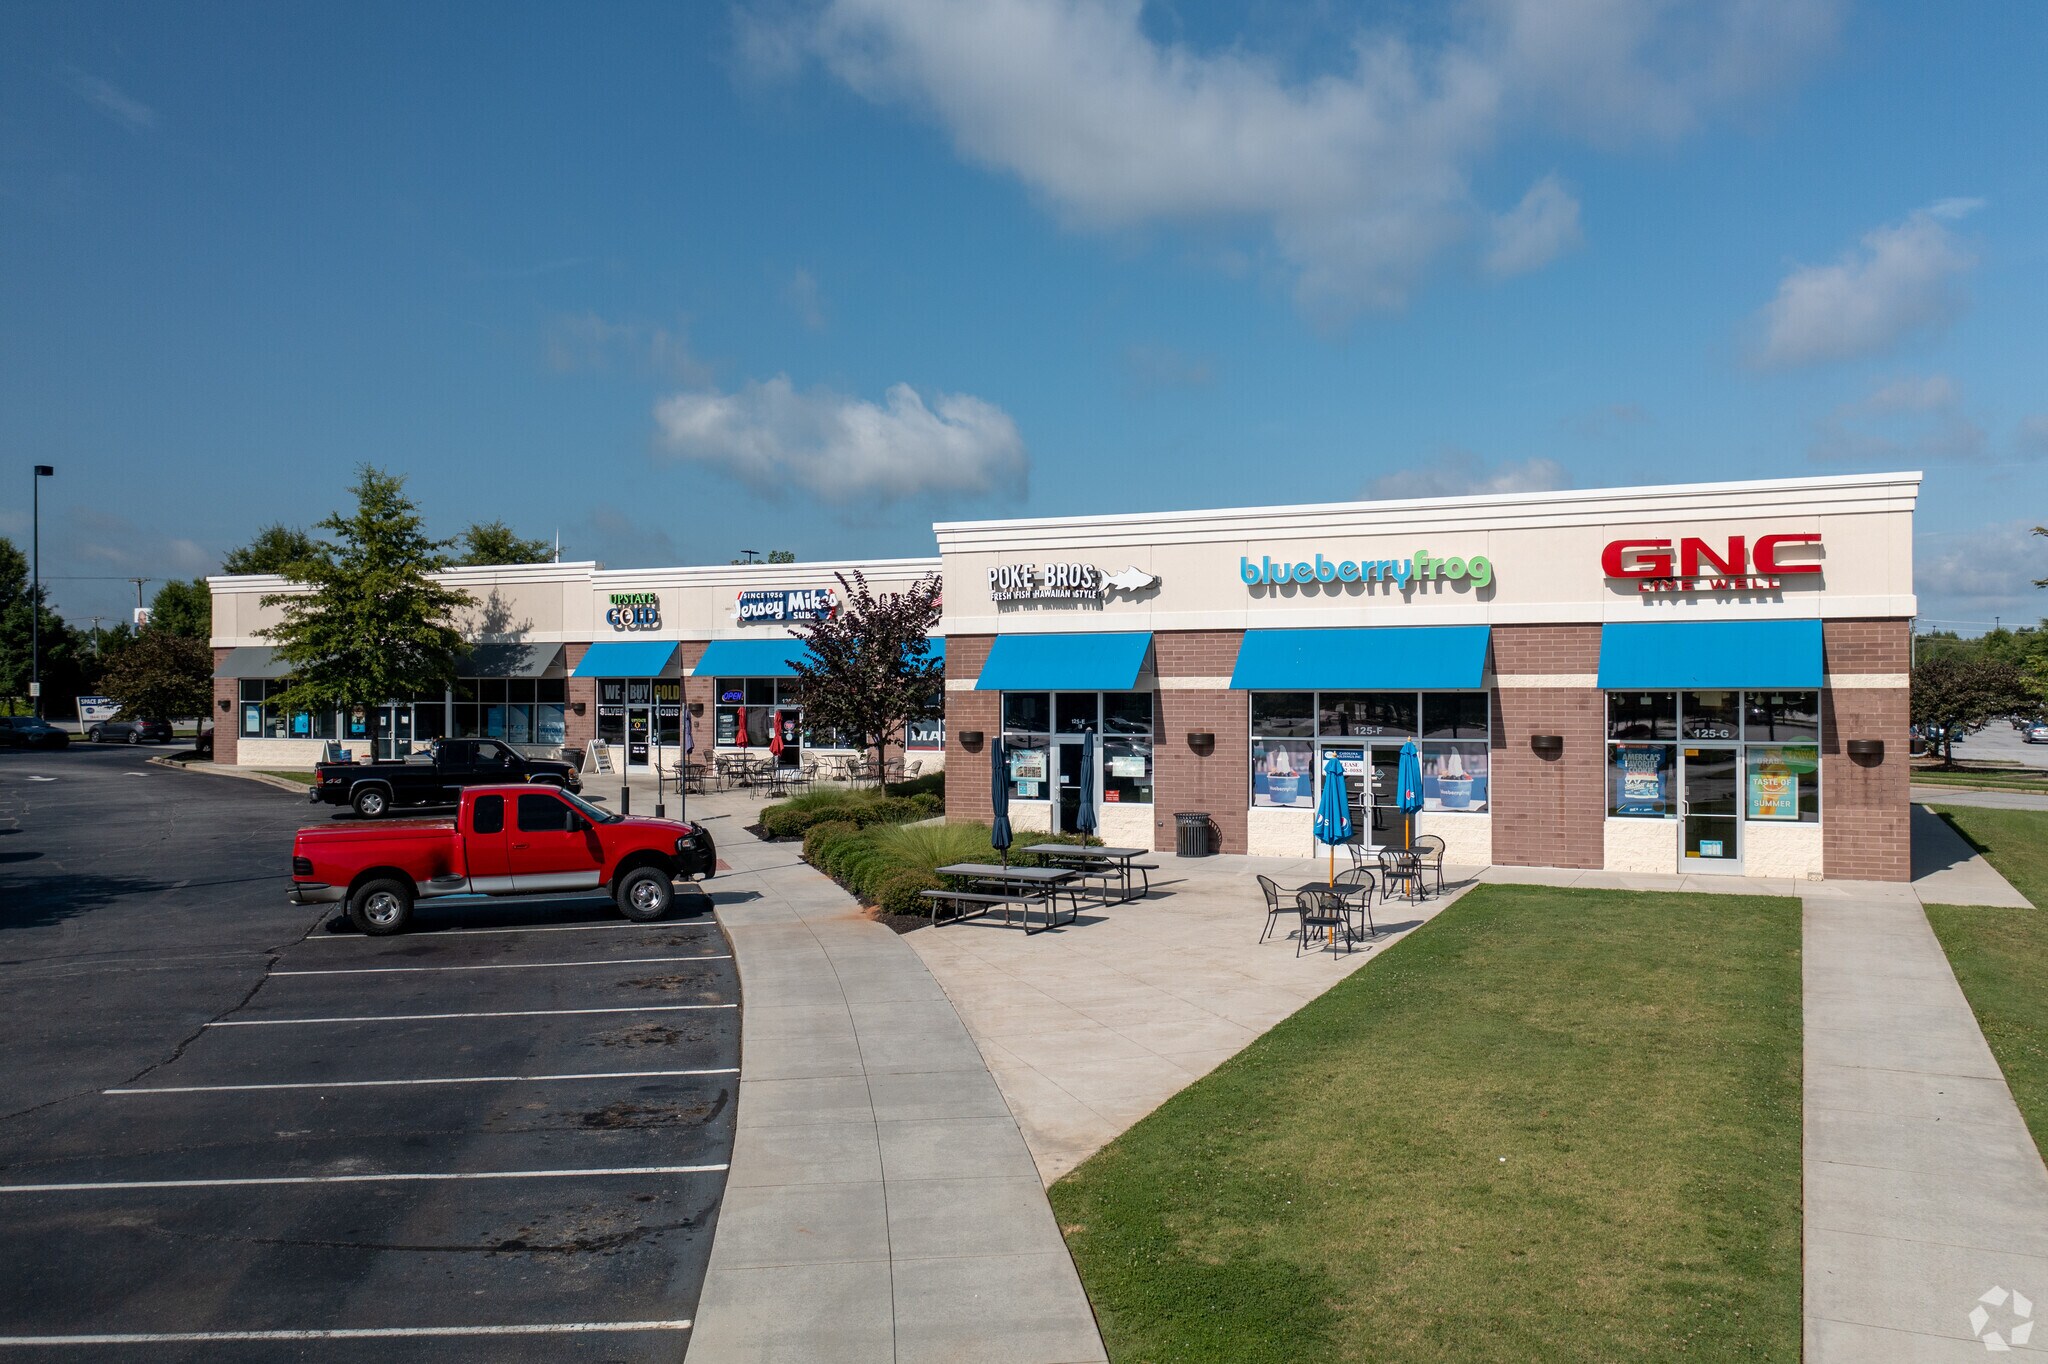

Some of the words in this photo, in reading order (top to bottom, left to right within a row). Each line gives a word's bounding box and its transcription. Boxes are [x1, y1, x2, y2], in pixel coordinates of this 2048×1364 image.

[1601, 533, 1822, 578] GNC
[987, 563, 1035, 591] POKE
[1638, 578, 1695, 592] LIVE
[1710, 578, 1781, 591] WELL
[608, 593, 655, 604] UPSTATE
[991, 591, 1012, 601] FRESH
[1014, 590, 1031, 600] FISH
[1033, 589, 1071, 598] HAWAIIAN
[1074, 589, 1097, 599] STYLE
[731, 598, 785, 620] Jersey
[606, 608, 657, 625] GOLD
[604, 685, 621, 699] WE
[630, 685, 649, 699] BUY
[654, 685, 680, 700] GOLD
[723, 691, 743, 700] OPEN
[1353, 726, 1383, 735] 125-F
[1693, 729, 1729, 738] 125-G
[1622, 753, 1661, 761] AMERICA'S
[1756, 757, 1780, 765] GRAB
[1625, 760, 1657, 768] FAVORITE
[1752, 778, 1778, 786] TASTE
[1780, 778, 1792, 786] OF
[1753, 800, 1791, 808] SUMMER
